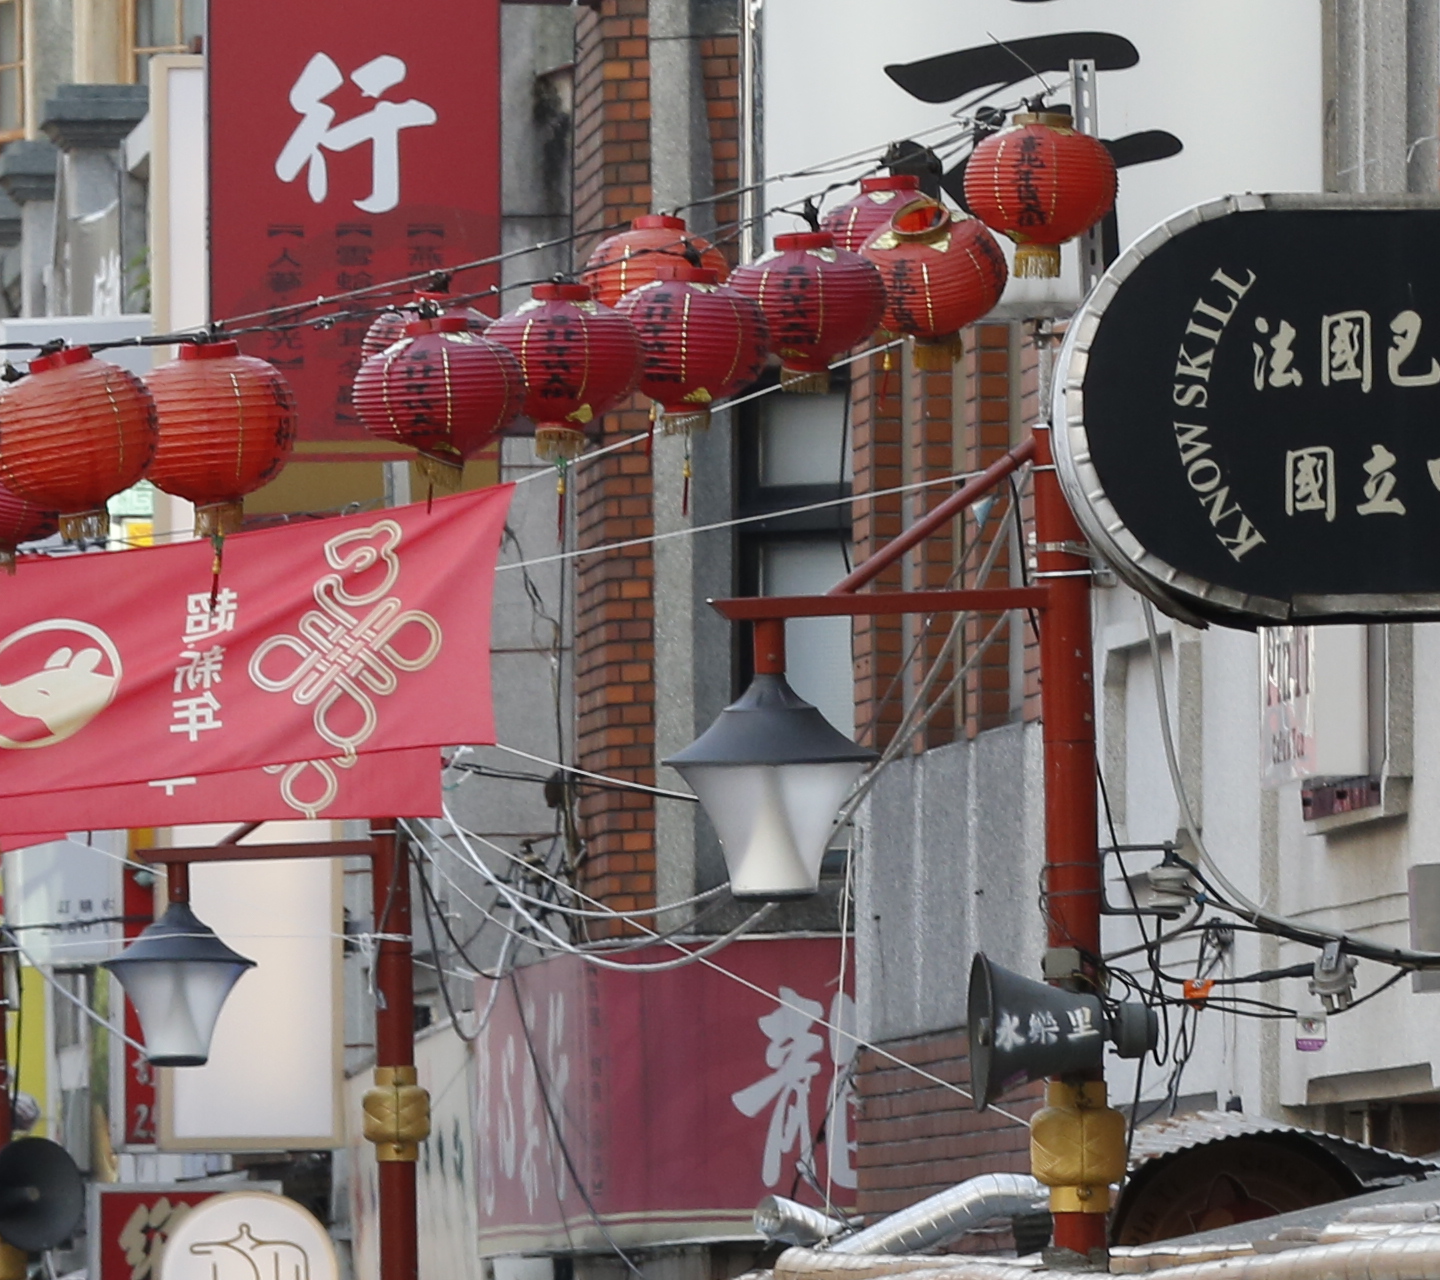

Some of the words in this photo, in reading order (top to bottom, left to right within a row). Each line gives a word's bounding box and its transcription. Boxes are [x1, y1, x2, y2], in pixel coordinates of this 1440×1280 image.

[274, 51, 438, 214] 行
[1172, 265, 1258, 409] SKILL
[1172, 419, 1268, 563] KNOW
